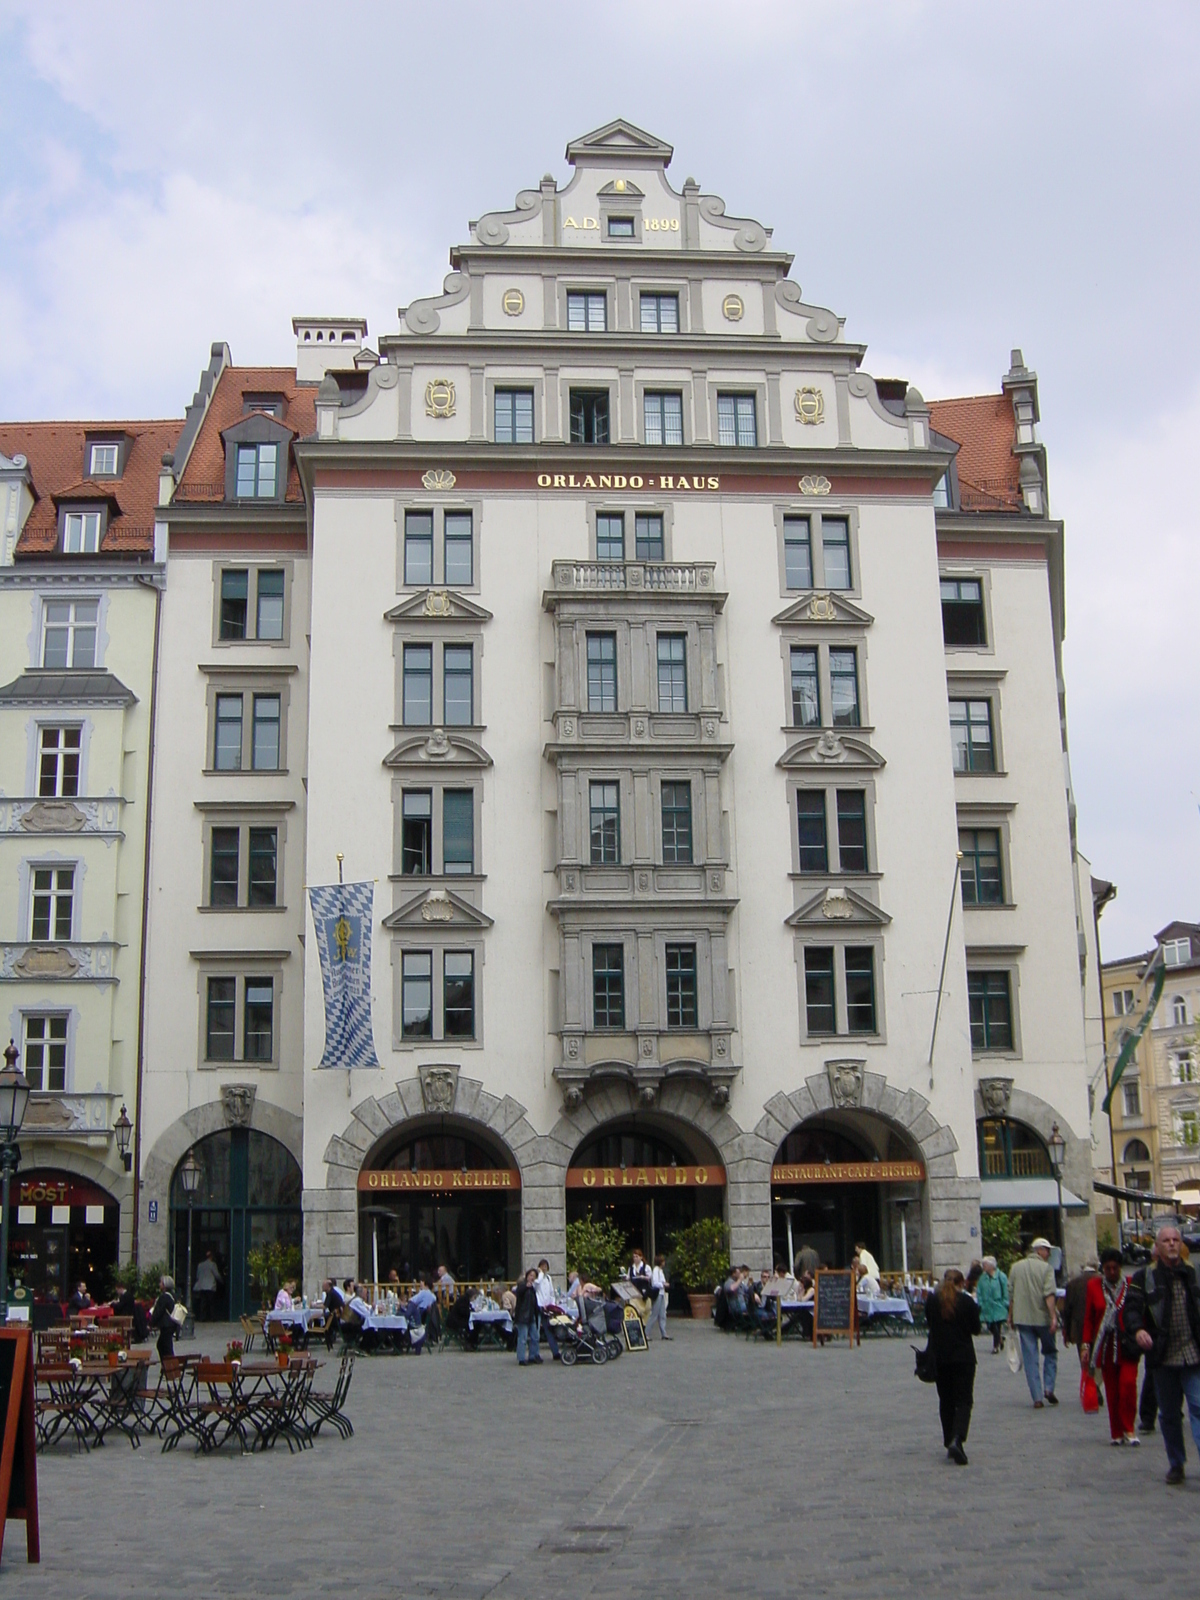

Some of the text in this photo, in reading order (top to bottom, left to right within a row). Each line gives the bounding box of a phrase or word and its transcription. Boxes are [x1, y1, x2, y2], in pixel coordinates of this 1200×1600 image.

[562, 216, 680, 231] A.D. 1899
[537, 474, 644, 489] ORLANDO
[659, 475, 720, 490] HAUS
[368, 1172, 511, 1188] ORLANDO KELLER
[582, 1166, 709, 1187] ORLANDO
[20, 1187, 68, 1202] MOST
